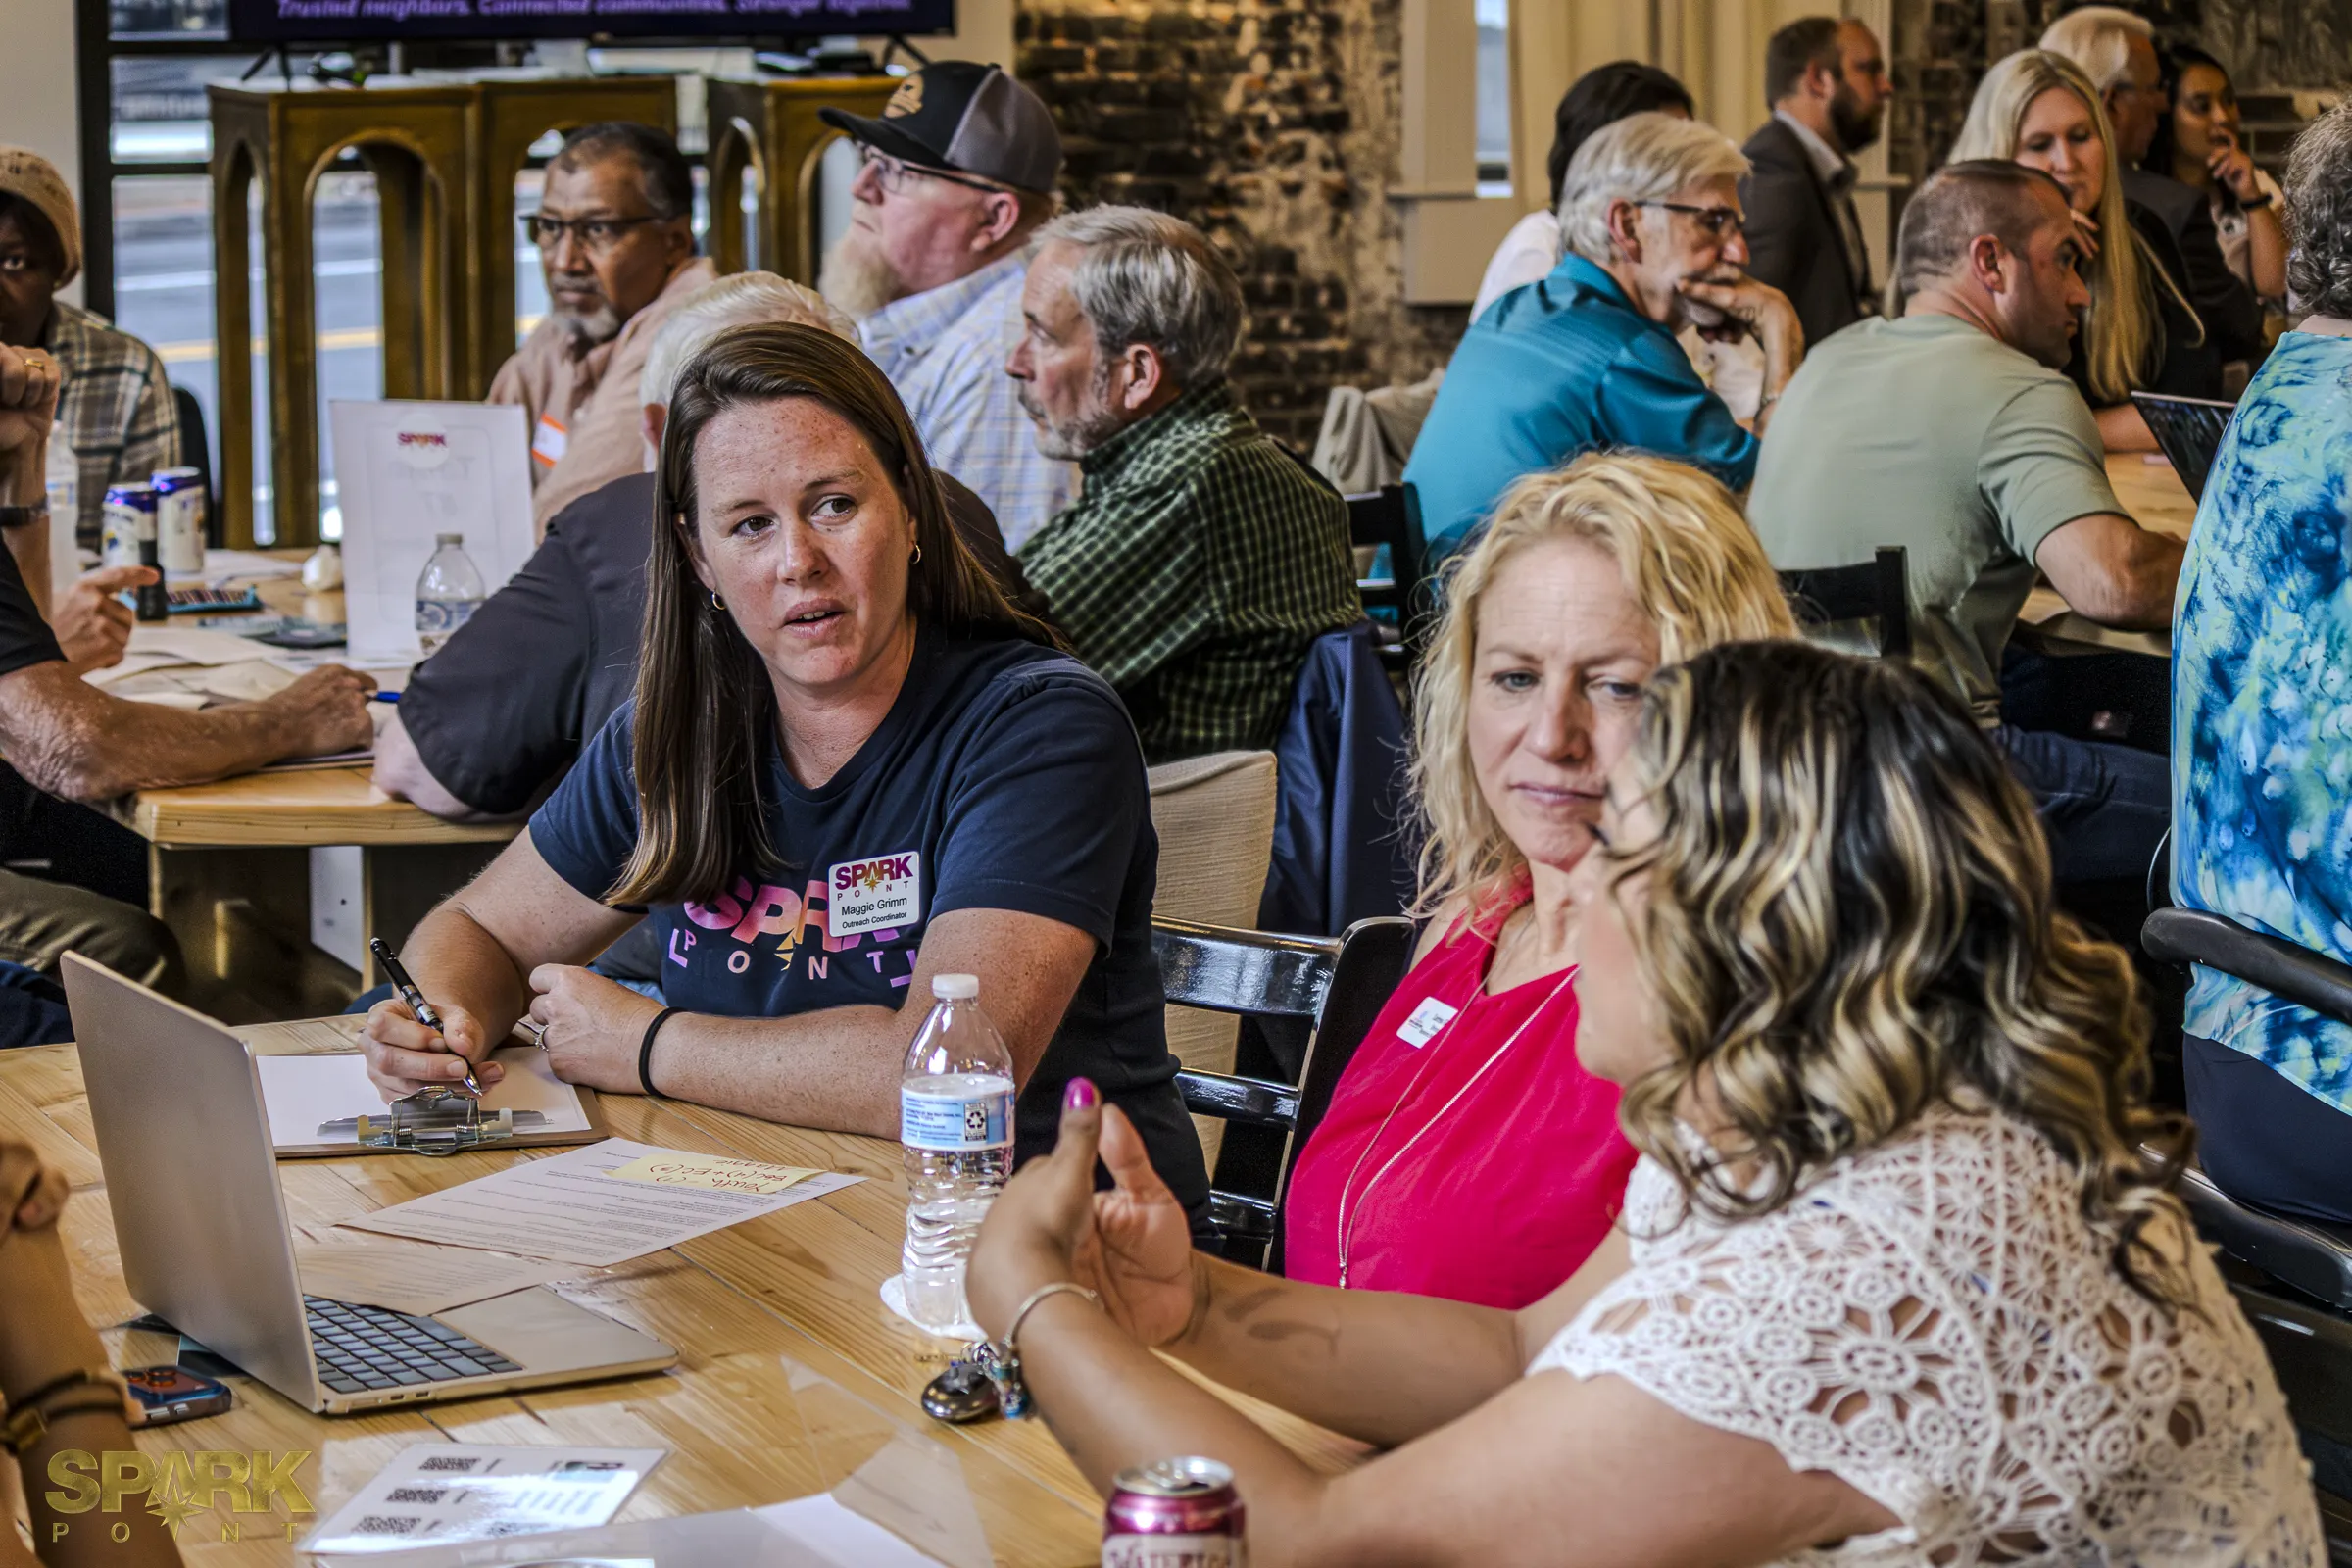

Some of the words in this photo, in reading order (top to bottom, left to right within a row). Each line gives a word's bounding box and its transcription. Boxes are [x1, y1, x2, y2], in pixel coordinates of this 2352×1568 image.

[835, 855, 913, 890] SPARK
[841, 902, 874, 916] Maggie
[877, 897, 907, 909] Grimm
[842, 917, 870, 929] Outreach
[871, 911, 907, 924] Coordinator
